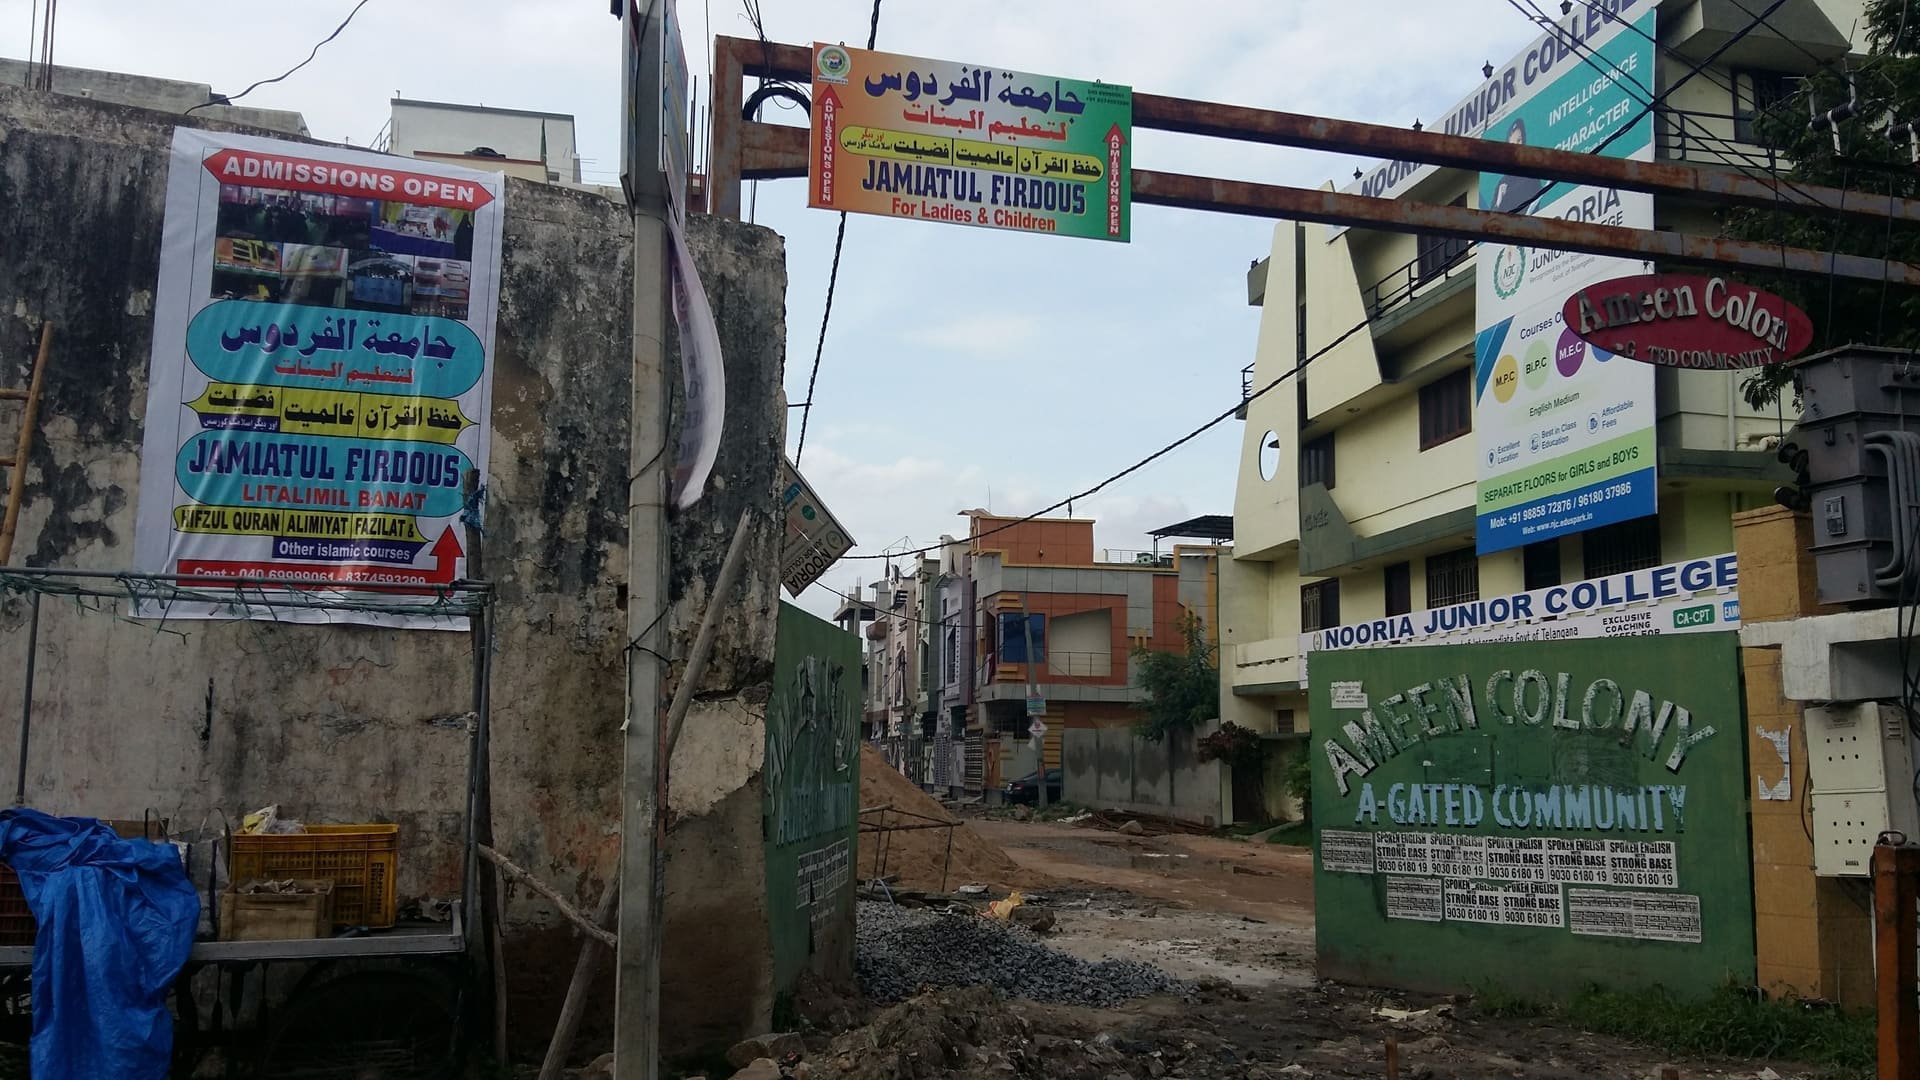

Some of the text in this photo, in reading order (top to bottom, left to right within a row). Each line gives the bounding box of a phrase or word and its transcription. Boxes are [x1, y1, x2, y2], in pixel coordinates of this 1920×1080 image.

[865, 66, 991, 105] الفردوس
[1549, 52, 1638, 127] INTELLIGENCE
[998, 71, 1086, 124] جامعة
[822, 97, 834, 202] ADMISSIONS OPEN
[1072, 156, 1102, 177] حفظ
[223, 156, 475, 203] ADMISSIONS OPEN
[863, 159, 1086, 214] JAMIATUL FIRDOUS
[1110, 134, 1120, 233] ADMISSIONS OPEN
[891, 198, 1056, 231] For Ladies & Children
[1578, 285, 1698, 334] Ameen
[1520, 317, 1553, 340] Courses
[219, 315, 456, 369] جامعة الفردوس
[1559, 342, 1583, 361] M.E.C
[1496, 371, 1515, 387] M.P.C
[1529, 392, 1580, 417] English Medium
[1601, 399, 1634, 418] Affordable
[427, 406, 463, 430] حفظ
[1602, 418, 1617, 429] Fees
[1541, 428, 1554, 439] Best
[1561, 420, 1577, 433] Class
[1541, 435, 1569, 450] Education
[188, 439, 461, 488] JAMIATUL FIRDOUS
[1497, 451, 1519, 465] Location
[1484, 446, 1639, 503] SEPARATE FLOORS for GIRLS and BOYS
[241, 484, 427, 510] LITALIMIL BANAT
[1490, 515, 1507, 529] Mob:
[1508, 511, 1521, 524] +91
[1523, 503, 1546, 520] 98858
[1548, 498, 1571, 514] 72876
[1578, 490, 1603, 506] 96180
[1605, 481, 1632, 499] 37986
[181, 509, 228, 529] HIFZUL
[233, 511, 280, 532] QURAN
[286, 514, 348, 535] ALIMIYAT
[355, 516, 406, 537] FAZILAT
[279, 541, 410, 561] Other islamic courses
[787, 548, 832, 589] NOORIA
[1326, 556, 1737, 649] NOORIA JUNIOR COLLEGE
[1603, 612, 1651, 625] EXCLUSIVE
[1676, 608, 1710, 626] CA-CPT
[1541, 626, 1578, 640] Telangana
[1605, 621, 1650, 633] COACHING
[1324, 673, 1480, 797] AMEEN
[1485, 669, 1718, 773] COLONY
[1355, 782, 1688, 833] A-GATED COMMUNITY
[1377, 847, 1427, 858] STRONG BASE
[1488, 852, 1520, 864] STRONG
[1523, 853, 1544, 865] BASE
[1548, 854, 1582, 865] STRONG
[1584, 855, 1606, 866] BASE
[1378, 860, 1396, 871] 9030
[1398, 861, 1416, 872] 6180
[1418, 862, 1427, 872] 19
[1431, 863, 1484, 876] 9030 6180 19
[1611, 857, 1647, 869] STRONG
[1649, 858, 1672, 870] BASE
[1490, 867, 1544, 880] 9030 6180 19
[1551, 869, 1571, 880] 9030
[1573, 870, 1594, 882] 6180
[1597, 870, 1607, 882] 19
[1613, 872, 1673, 886] 9030 6180 19
[1446, 893, 1477, 904] STRONG
[1479, 894, 1499, 906] BASE
[1503, 897, 1537, 909] STRONG
[1538, 898, 1560, 910] BASE
[1446, 907, 1466, 919] 9030
[1468, 908, 1487, 920] 6180
[1490, 910, 1499, 921] 19
[1505, 910, 1525, 922] 9030
[1528, 912, 1548, 924] 6180
[1550, 913, 1561, 925] 19
